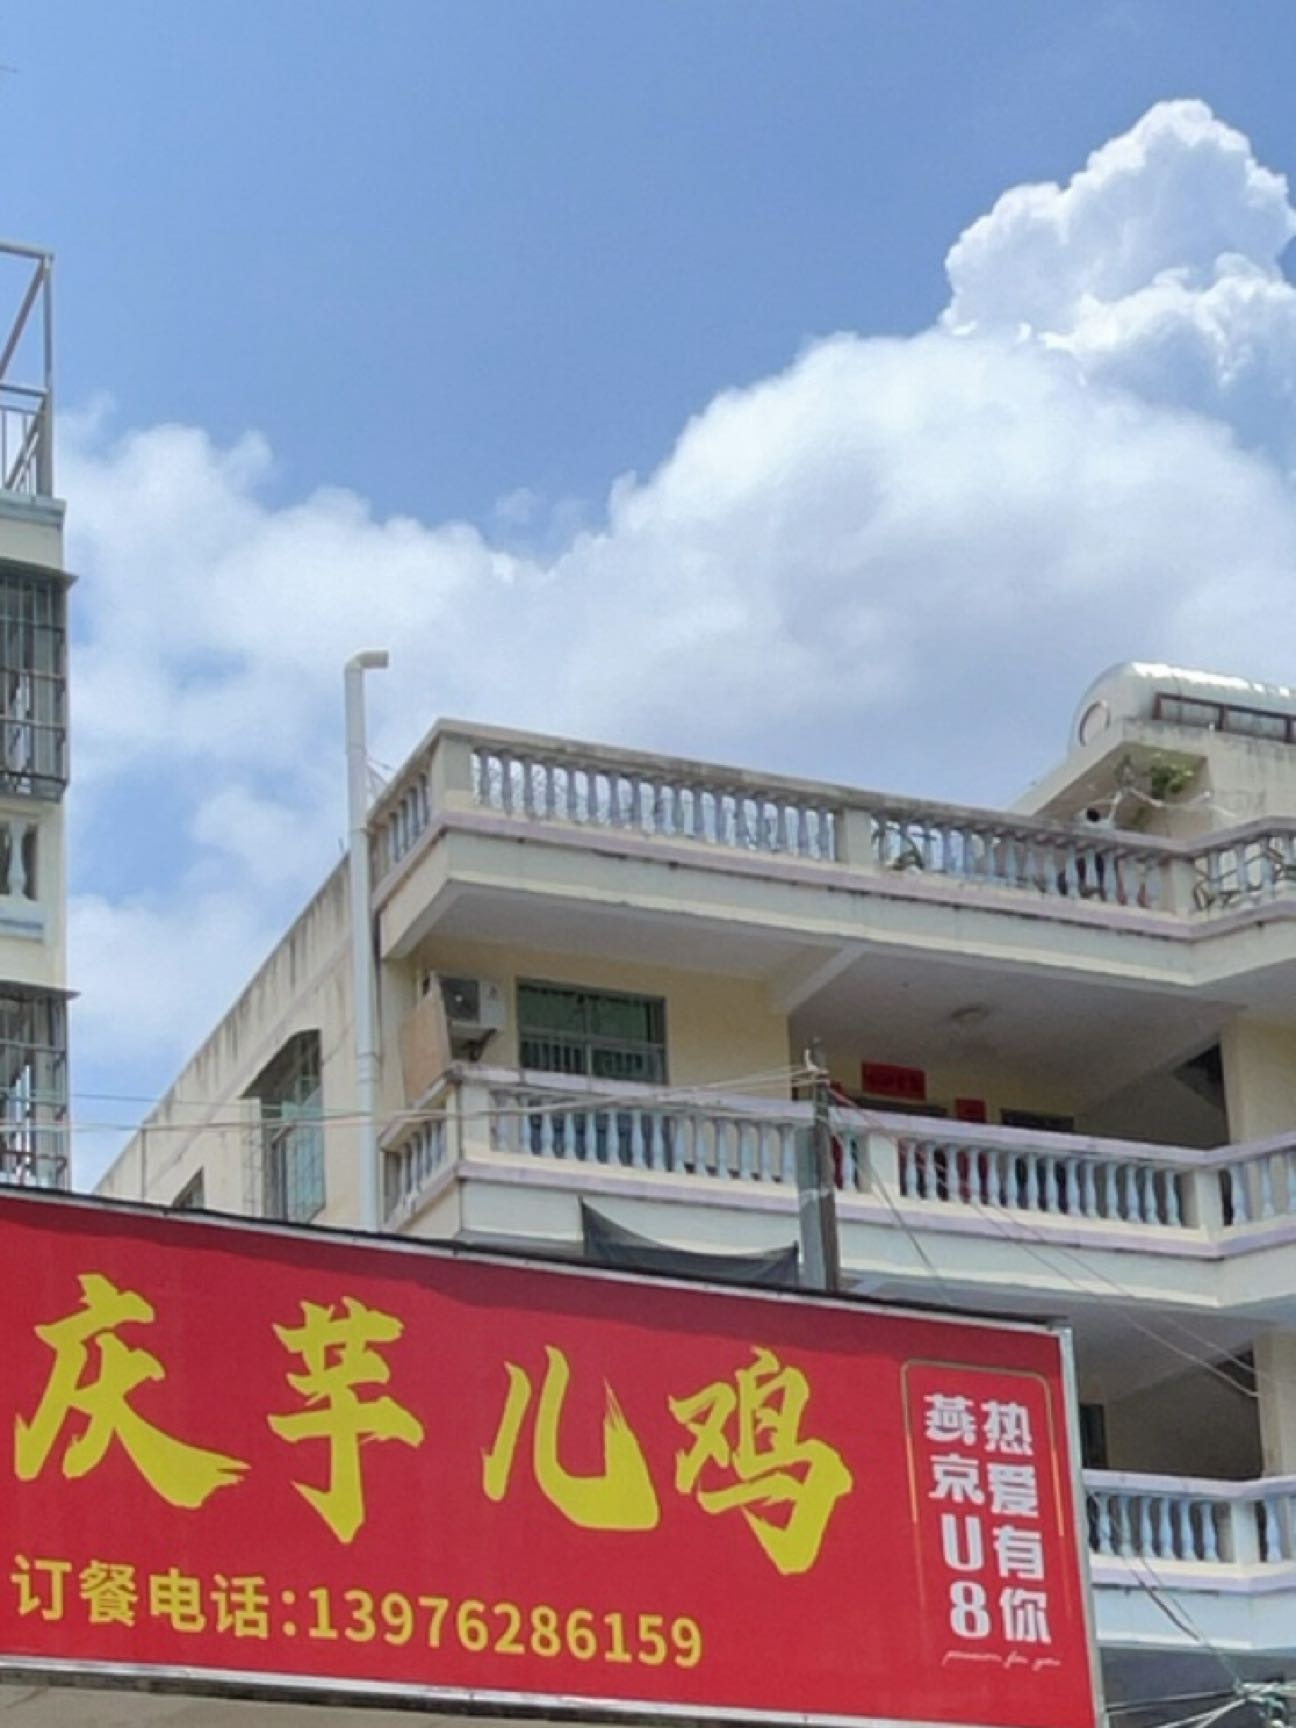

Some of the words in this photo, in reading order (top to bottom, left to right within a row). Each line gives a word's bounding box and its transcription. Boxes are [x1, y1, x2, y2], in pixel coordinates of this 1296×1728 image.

[923, 1393, 991, 1641] 燕京U8
[981, 1400, 1052, 1645] 热爱有你
